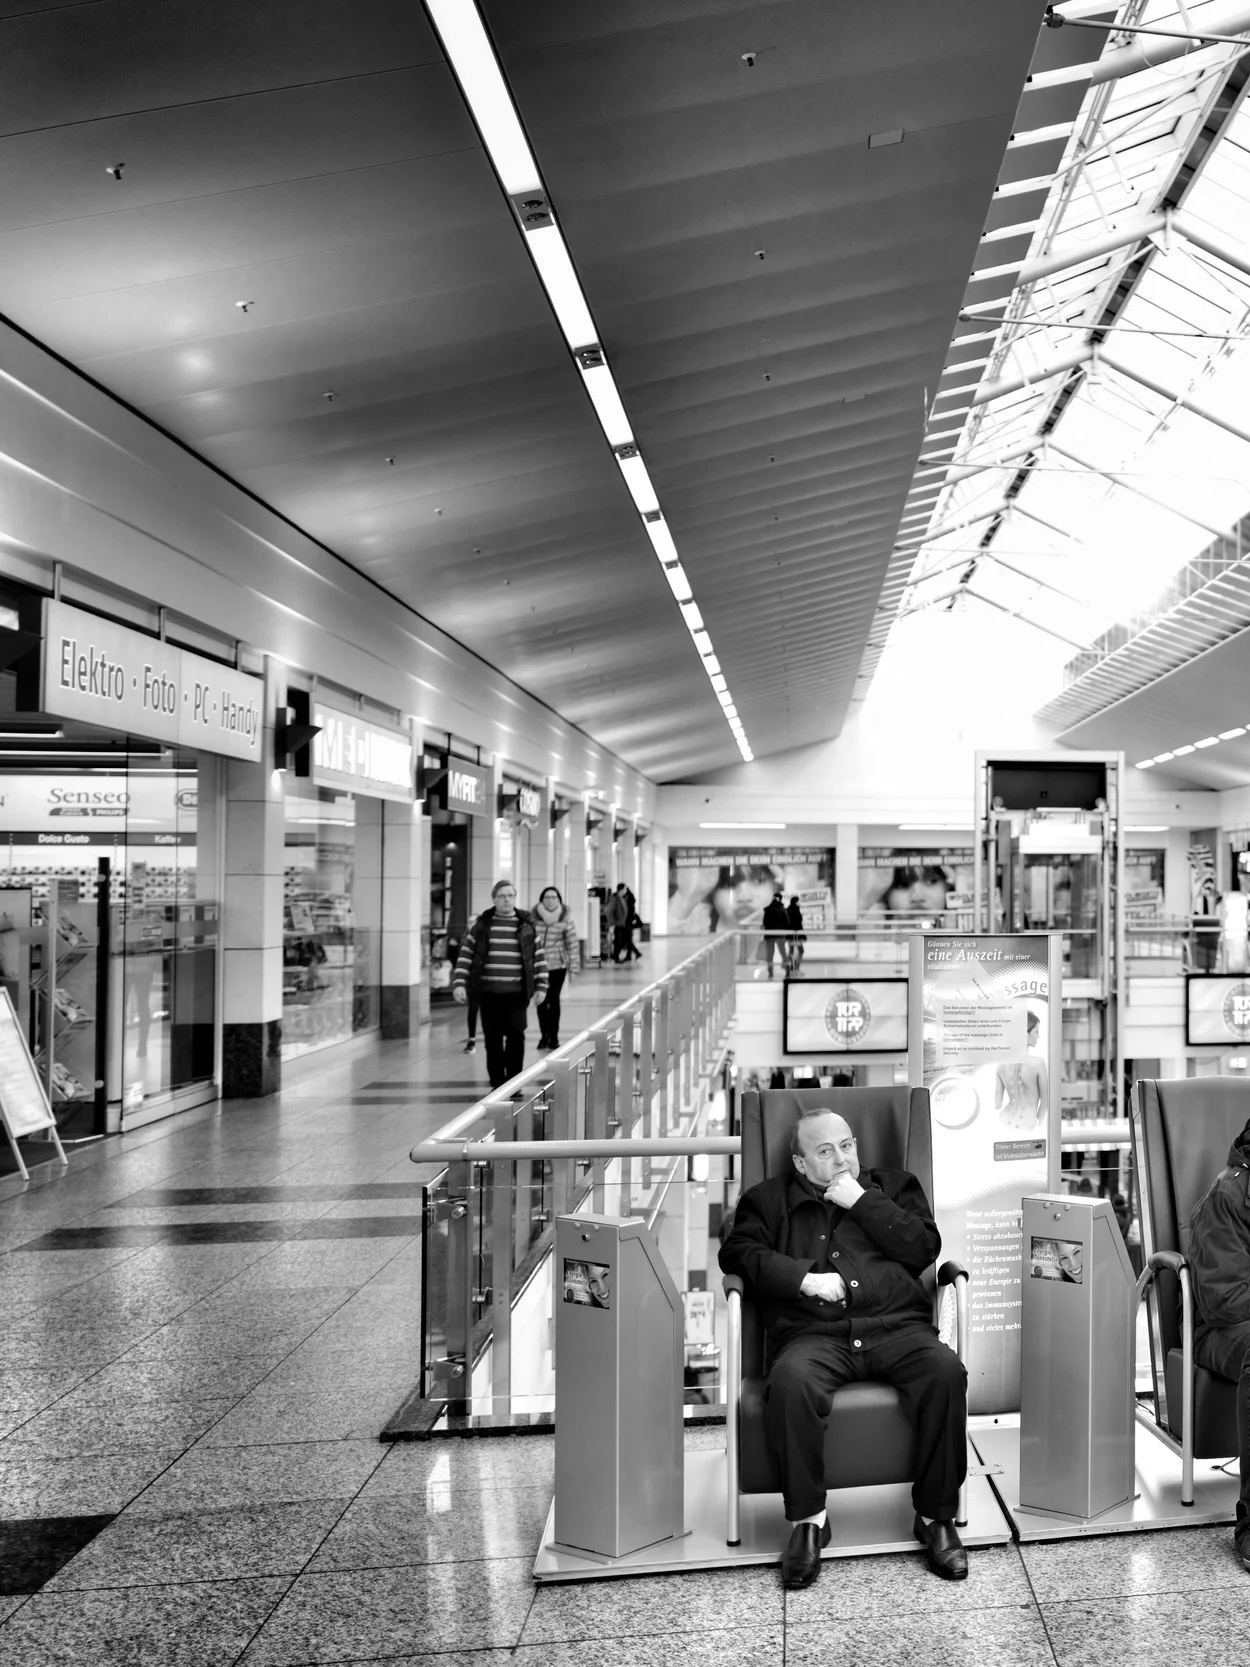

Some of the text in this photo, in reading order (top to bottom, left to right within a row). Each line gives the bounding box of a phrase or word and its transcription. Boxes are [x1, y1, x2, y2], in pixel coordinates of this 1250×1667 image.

[60, 637, 259, 746] Elektro Foto PC Handy
[48, 788, 131, 804] Senseo
[38, 834, 90, 844] Dolce Gusto
[952, 941, 963, 949] Sie
[928, 948, 1031, 961] eine Auszeit mit einer
[1003, 1151, 1044, 1159] Videoüberwacht
[966, 1210, 983, 1218] Diese
[973, 1244, 1019, 1253] Verspannungen
[972, 1255, 983, 1263] die
[982, 1266, 1010, 1275] kräftigen
[989, 1277, 1012, 1287] Energie
[972, 1290, 1002, 1300] gewinnen
[972, 1300, 1022, 1309] das Immunsyste
[982, 1312, 1005, 1320] stärken
[972, 1322, 1022, 1332] und vieles mehr.
